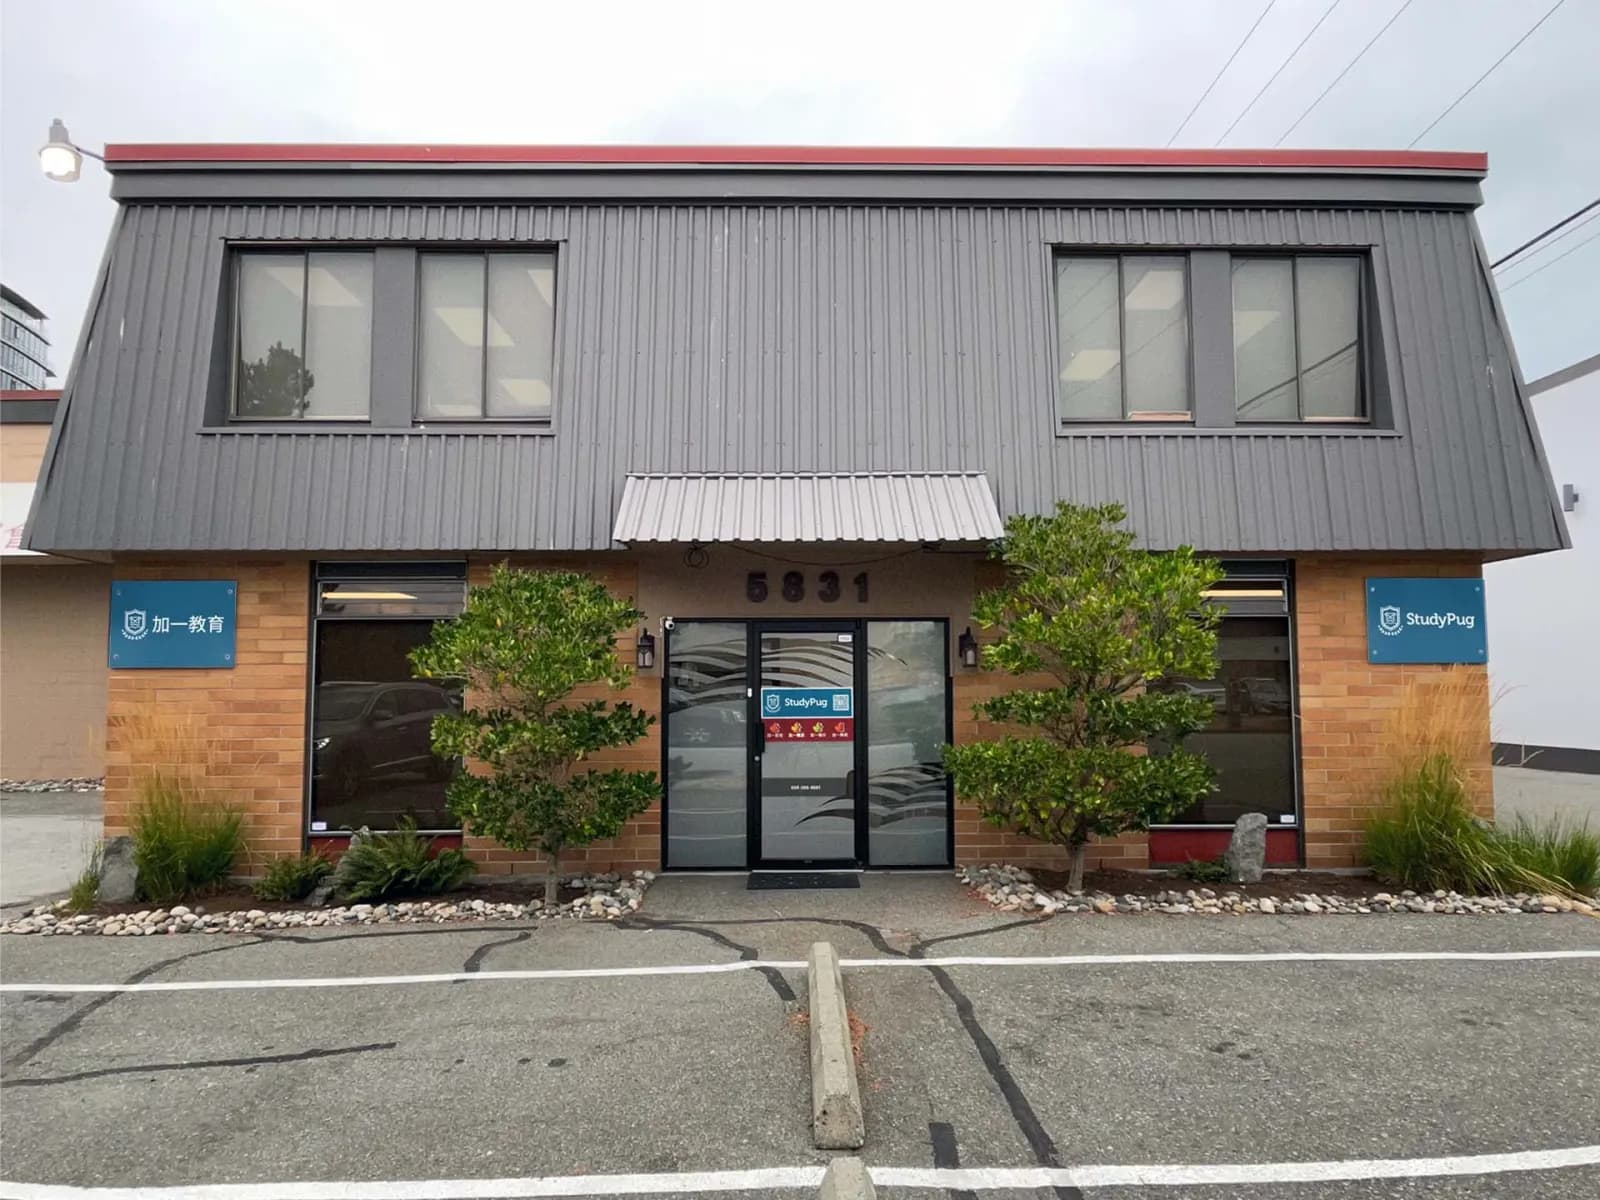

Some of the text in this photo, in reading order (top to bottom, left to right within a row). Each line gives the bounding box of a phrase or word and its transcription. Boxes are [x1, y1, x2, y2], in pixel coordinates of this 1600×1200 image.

[746, 571, 869, 603] 5831
[152, 615, 224, 633] 加一教育
[1406, 612, 1475, 629] StudyPug
[784, 697, 828, 708] StudyPug
